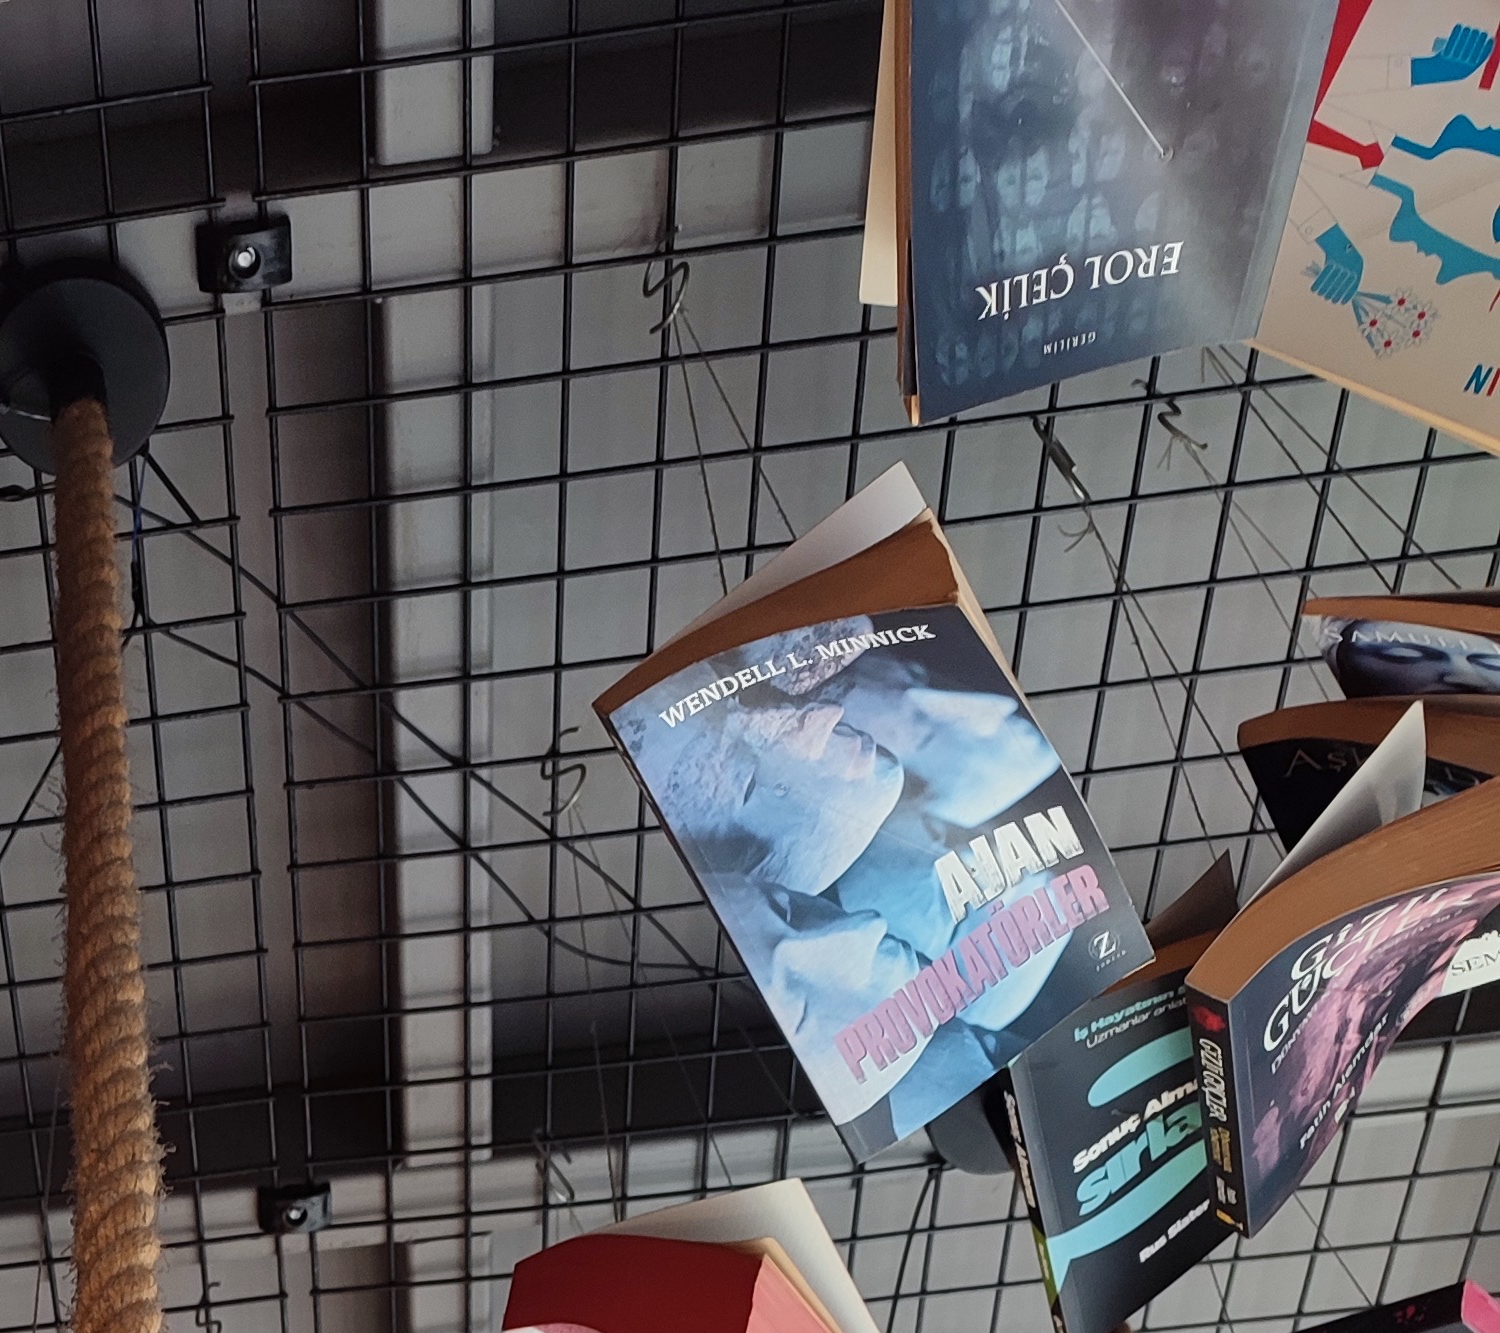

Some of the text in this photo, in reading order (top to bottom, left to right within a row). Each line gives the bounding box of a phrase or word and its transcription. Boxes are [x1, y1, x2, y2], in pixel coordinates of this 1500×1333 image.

[974, 240, 1183, 320] EROL ÇELİK
[658, 620, 937, 727] WENDELL L. MINNICK
[931, 803, 1085, 922] AJAN
[835, 863, 1108, 1085] PROVOKATÖRLER
[1072, 1110, 1141, 1174] Sonuç
